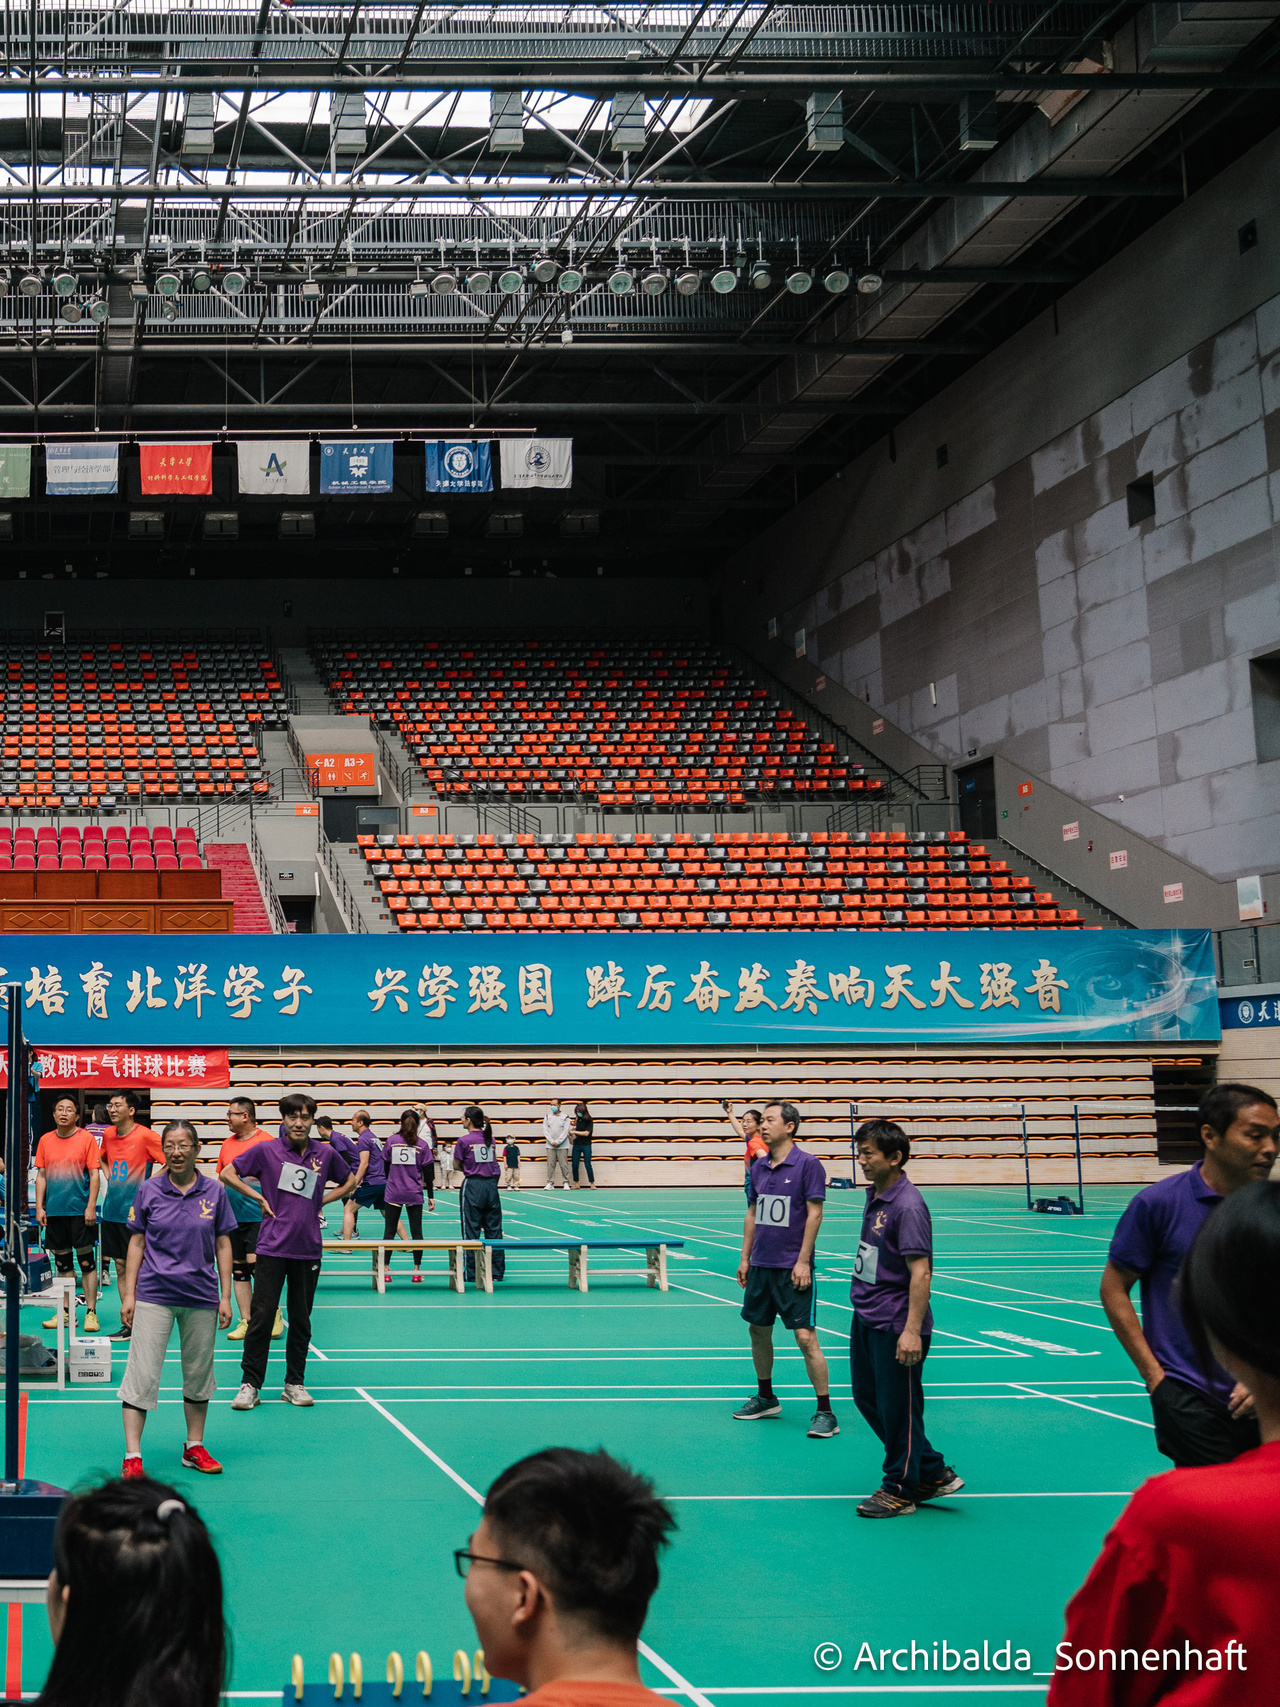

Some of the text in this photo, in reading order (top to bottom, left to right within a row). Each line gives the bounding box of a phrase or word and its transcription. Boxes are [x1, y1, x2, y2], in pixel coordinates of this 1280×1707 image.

[323, 757, 356, 768] A2 A3
[367, 962, 555, 1018] 兴学强国
[585, 958, 1070, 1018] 踔厉奋发奏响天大强音
[399, 1148, 409, 1163] 5
[479, 1146, 489, 1161] 9
[111, 1160, 129, 1182] 69
[291, 1169, 308, 1192] 3
[757, 1198, 786, 1223] 10
[854, 1244, 868, 1275] 5
